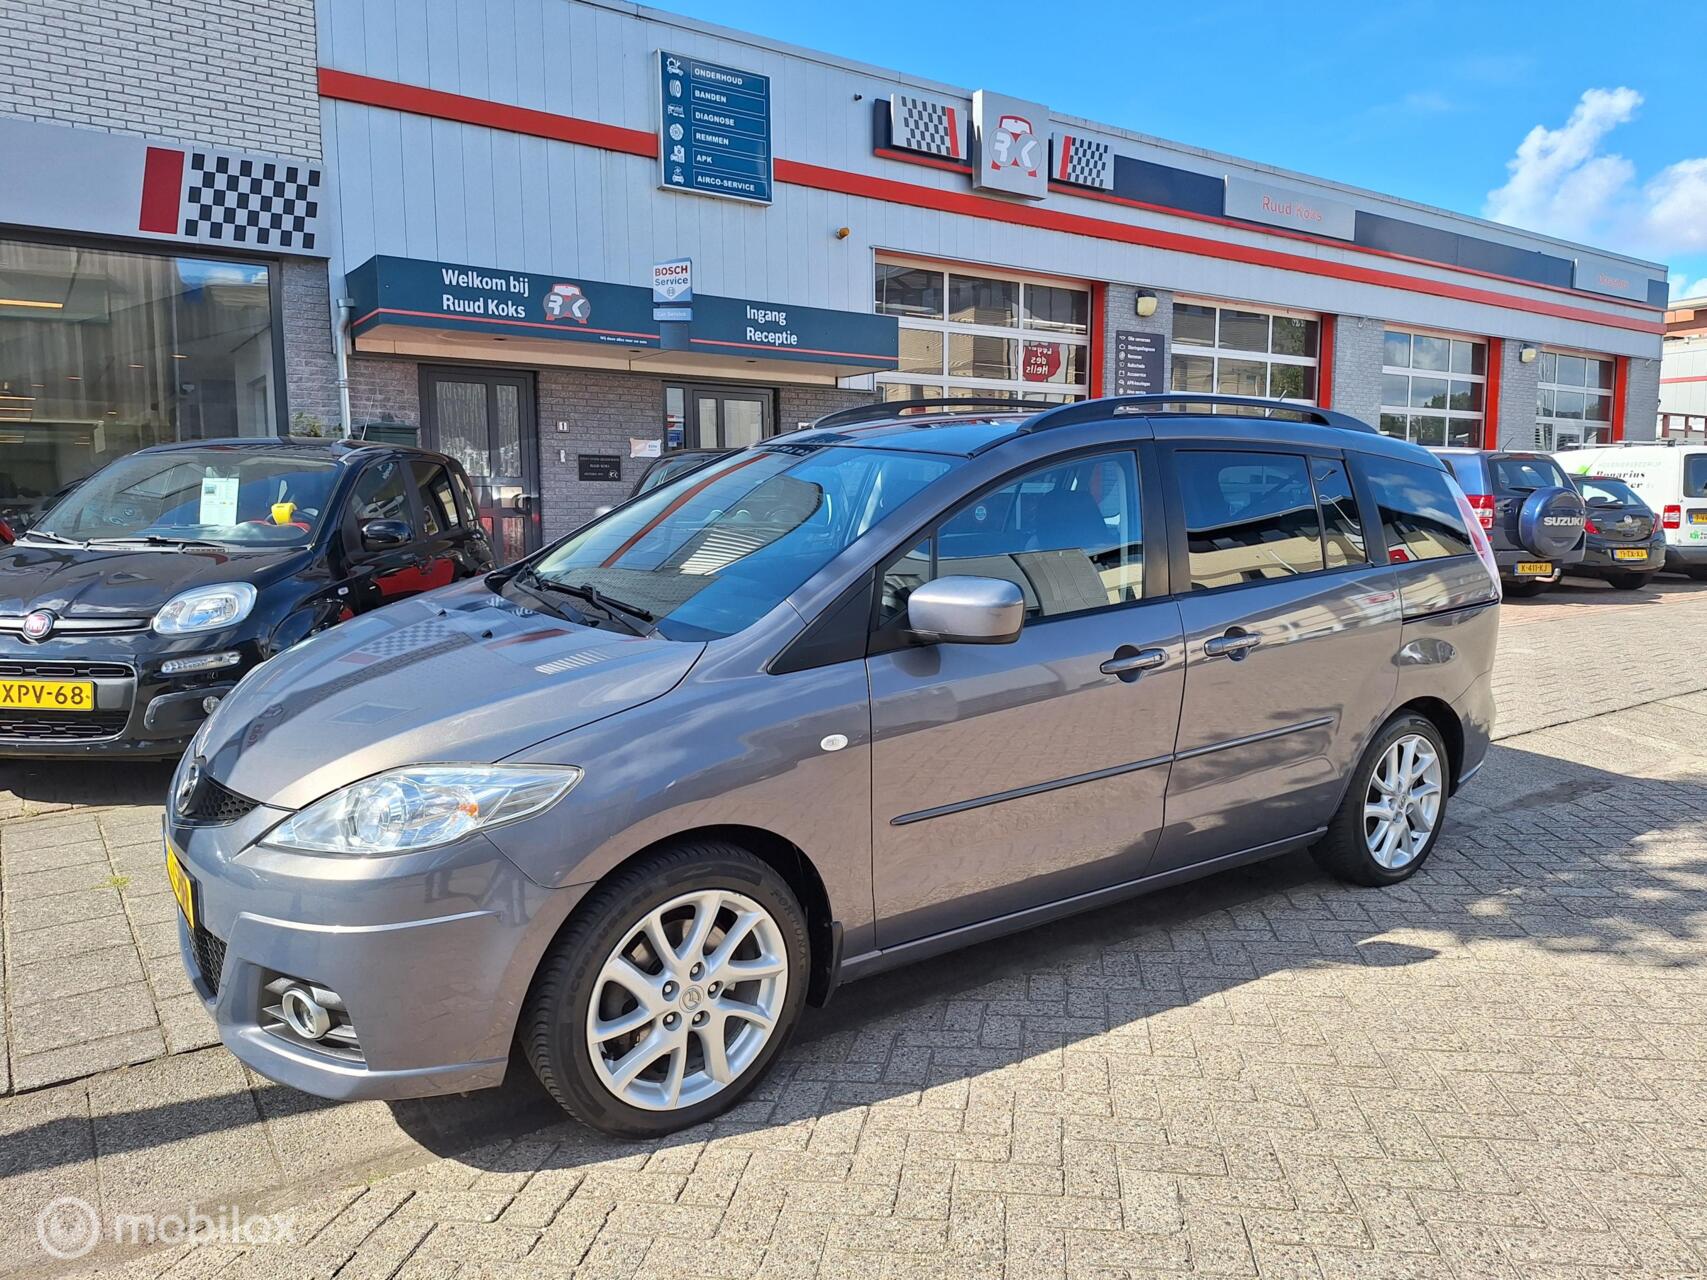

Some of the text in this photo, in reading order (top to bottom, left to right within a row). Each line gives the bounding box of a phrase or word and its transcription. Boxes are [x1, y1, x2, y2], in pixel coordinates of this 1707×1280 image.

[694, 67, 743, 86] ONDERHOUD
[694, 89, 727, 103] BANDEN
[695, 111, 735, 126] DIAGNOSE
[695, 132, 729, 146] REMMEN
[696, 154, 713, 164] APK
[697, 175, 756, 192] AIRCO-SERVICE
[1262, 195, 1292, 215] Ruud
[654, 264, 688, 277] BOSCH
[441, 268, 529, 297] Welkom bij
[654, 276, 689, 287] Service
[442, 294, 526, 318] Ruud Koks
[746, 304, 787, 326] Ingang
[746, 326, 798, 347] Receptie
[1543, 516, 1584, 527] SUZUKI
[2, 684, 84, 705] XPV-68
